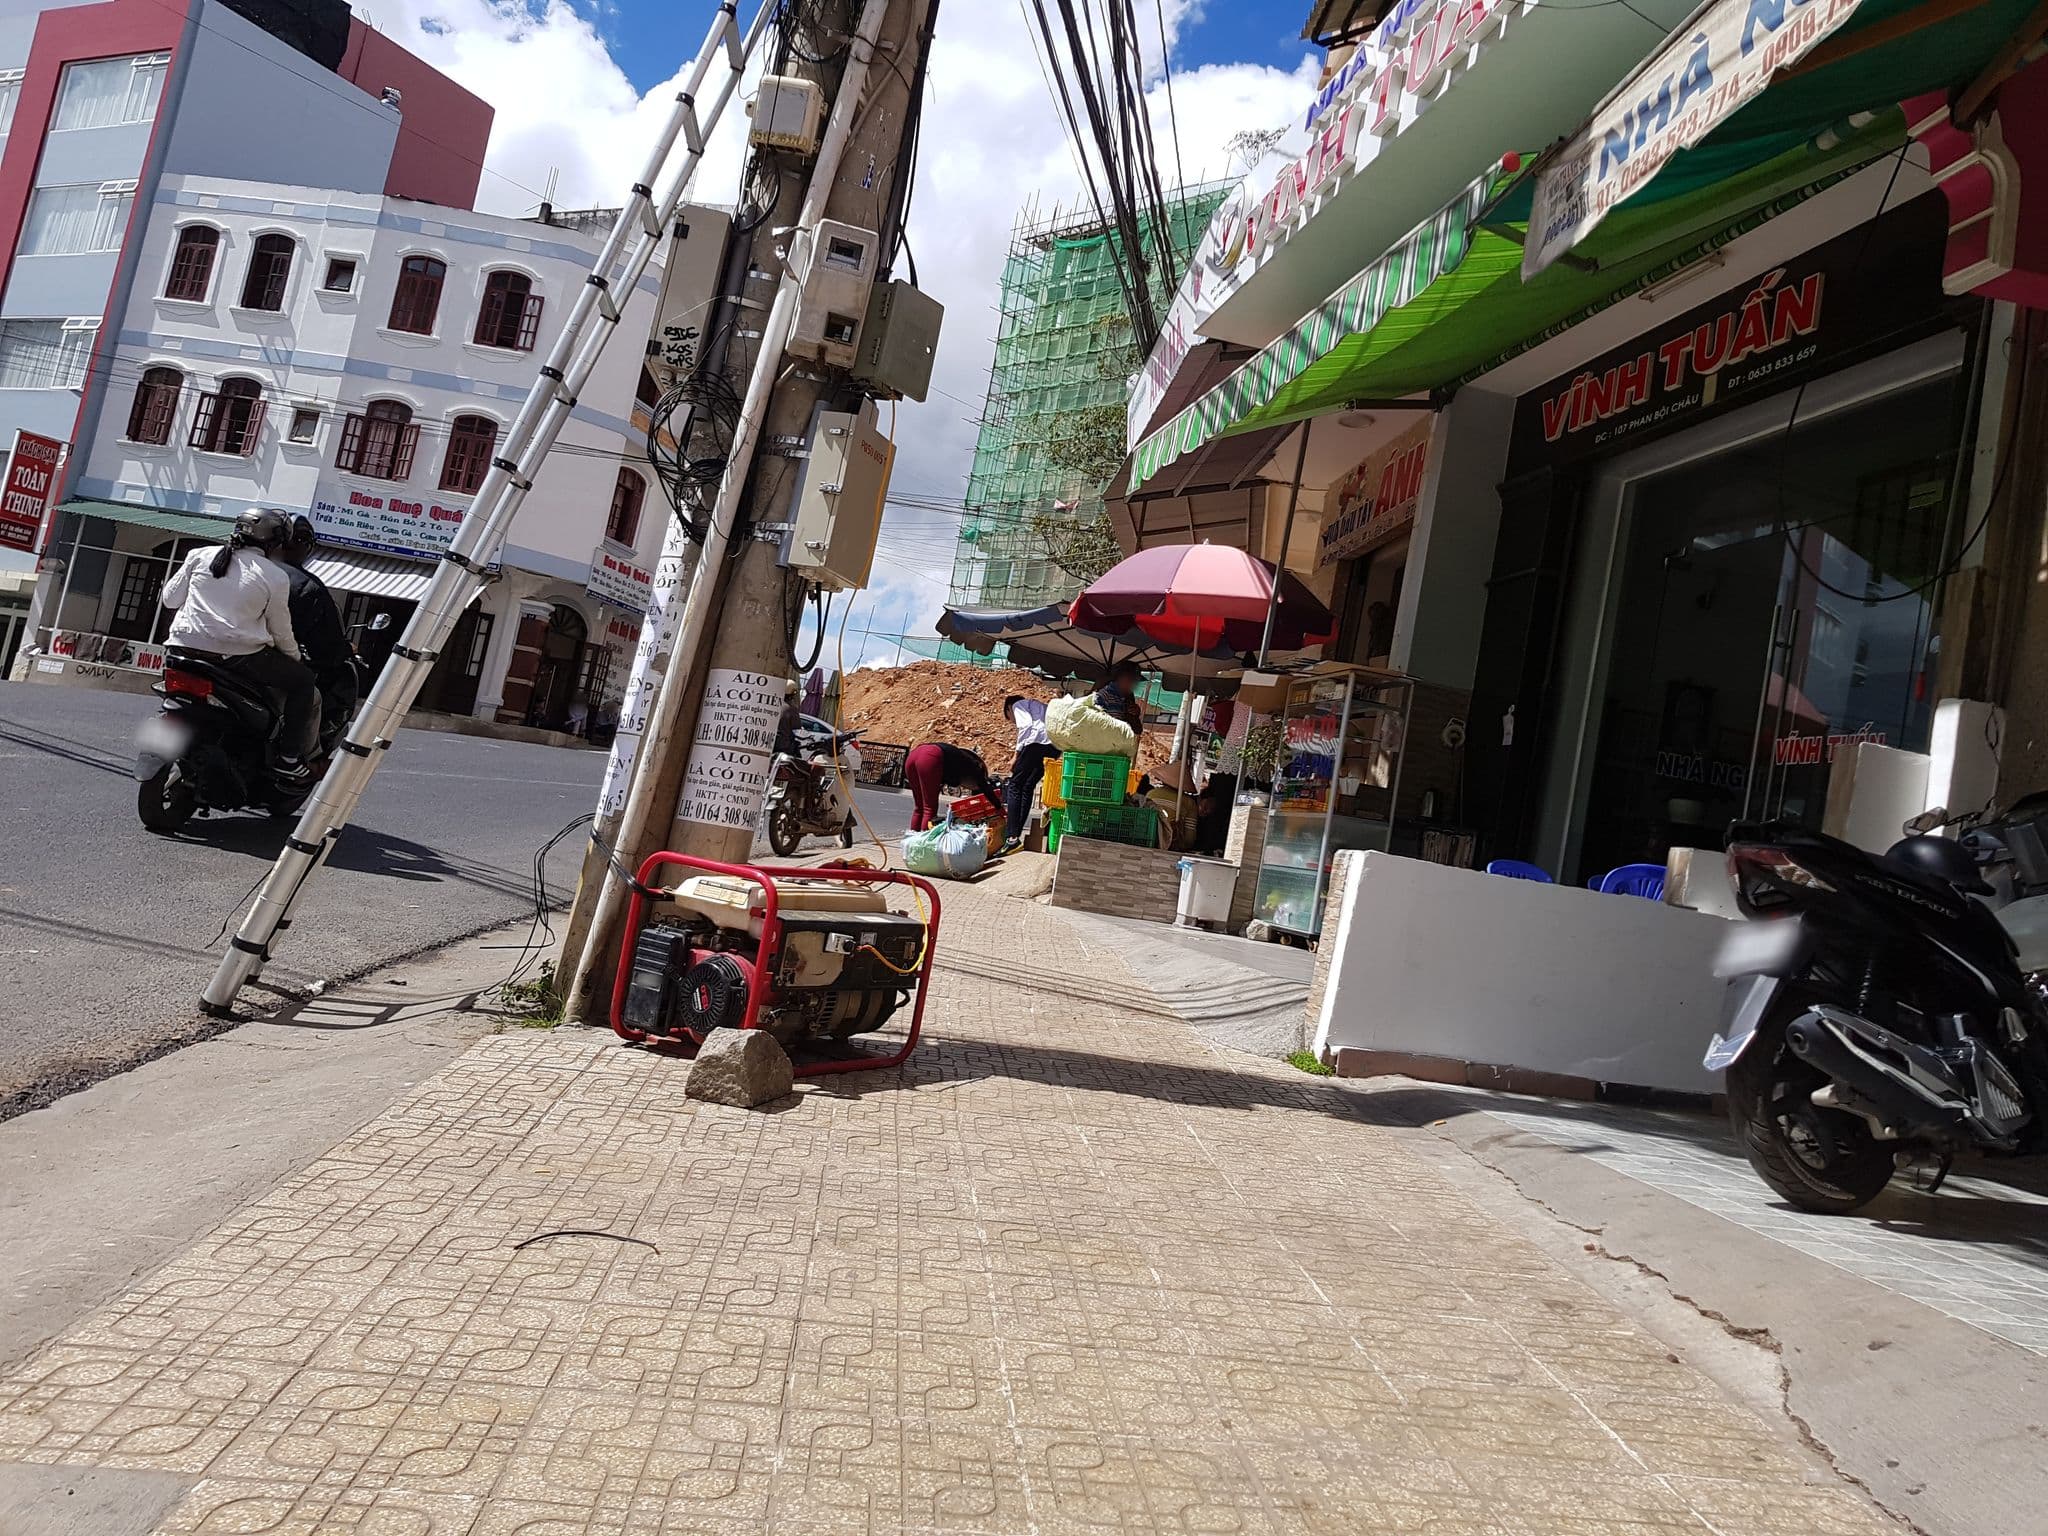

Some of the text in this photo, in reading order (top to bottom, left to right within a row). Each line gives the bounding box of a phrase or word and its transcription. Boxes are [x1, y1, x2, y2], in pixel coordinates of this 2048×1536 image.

[1597, 32, 1714, 183] NHÀ
[1740, 0, 1813, 59] N
[1542, 268, 1825, 442] VĨNH TUẤN
[1748, 363, 1772, 380] 0633
[14, 464, 48, 492] TOÀN
[5, 490, 44, 518] THỊNH
[349, 491, 465, 524] Hoa Huệ Quá
[731, 672, 768, 687] ALO
[704, 684, 721, 698] LÀ
[726, 688, 751, 702] CÓ
[713, 711, 737, 722] HKTT
[744, 715, 768, 727] CMND
[714, 724, 740, 743] 0164
[741, 727, 760, 747] 308
[715, 751, 751, 765] ALO
[1775, 730, 1823, 765] VĨNH
[688, 761, 704, 775] LÀ
[709, 766, 734, 780] CÓ
[695, 788, 719, 800] HKTT
[726, 794, 750, 806] CMND
[695, 802, 721, 822] 0164
[722, 806, 741, 825] 308
